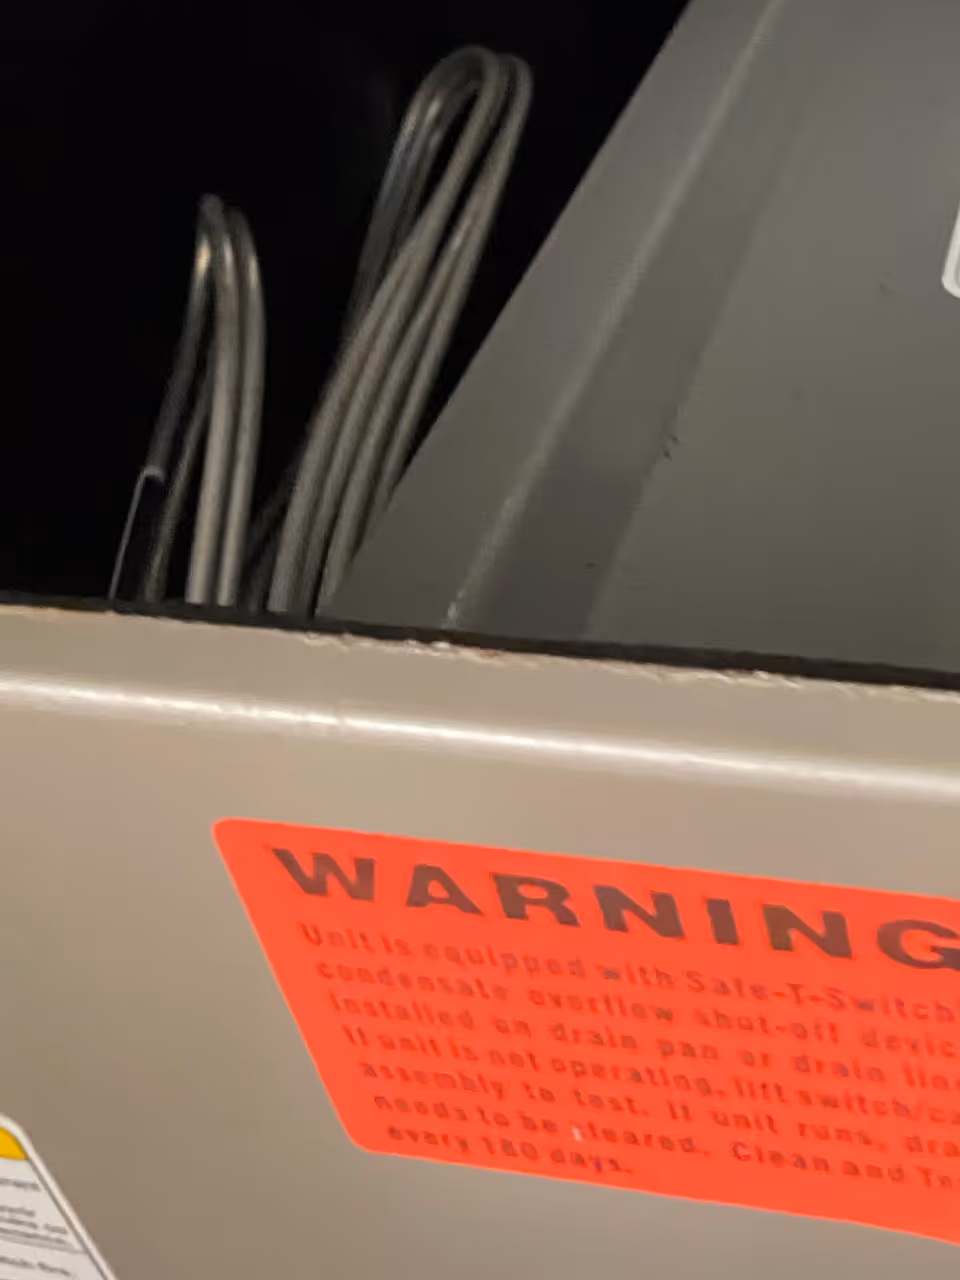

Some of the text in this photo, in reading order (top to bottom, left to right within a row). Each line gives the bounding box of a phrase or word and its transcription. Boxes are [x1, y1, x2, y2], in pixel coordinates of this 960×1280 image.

[299, 923, 372, 950] Unit
[380, 933, 411, 953] is
[420, 937, 588, 982] equipped
[596, 959, 672, 987] with
[314, 959, 511, 1000] condensate
[527, 986, 674, 1021] overflow
[693, 1007, 839, 1042] shut-off
[329, 993, 476, 1029] installed
[494, 1019, 531, 1035] on
[547, 1022, 638, 1049] drain
[657, 1040, 720, 1063] pan
[739, 1051, 772, 1066] or
[793, 1054, 885, 1081] drain
[344, 1027, 369, 1045] If
[377, 1032, 441, 1055] unit
[450, 1042, 478, 1059] is
[488, 1047, 539, 1068] not
[735, 1079, 786, 1101] lift
[357, 1058, 507, 1098] assembly
[523, 1082, 556, 1102] to
[573, 1090, 647, 1114] test.
[667, 1103, 692, 1120] If
[711, 1108, 777, 1132] unit
[372, 1092, 467, 1120] needs
[477, 1108, 510, 1126] to
[520, 1113, 559, 1132] be
[731, 1142, 830, 1173] Clean
[843, 1159, 905, 1182] and
[386, 1126, 471, 1152] every
[483, 1137, 539, 1161] 180
